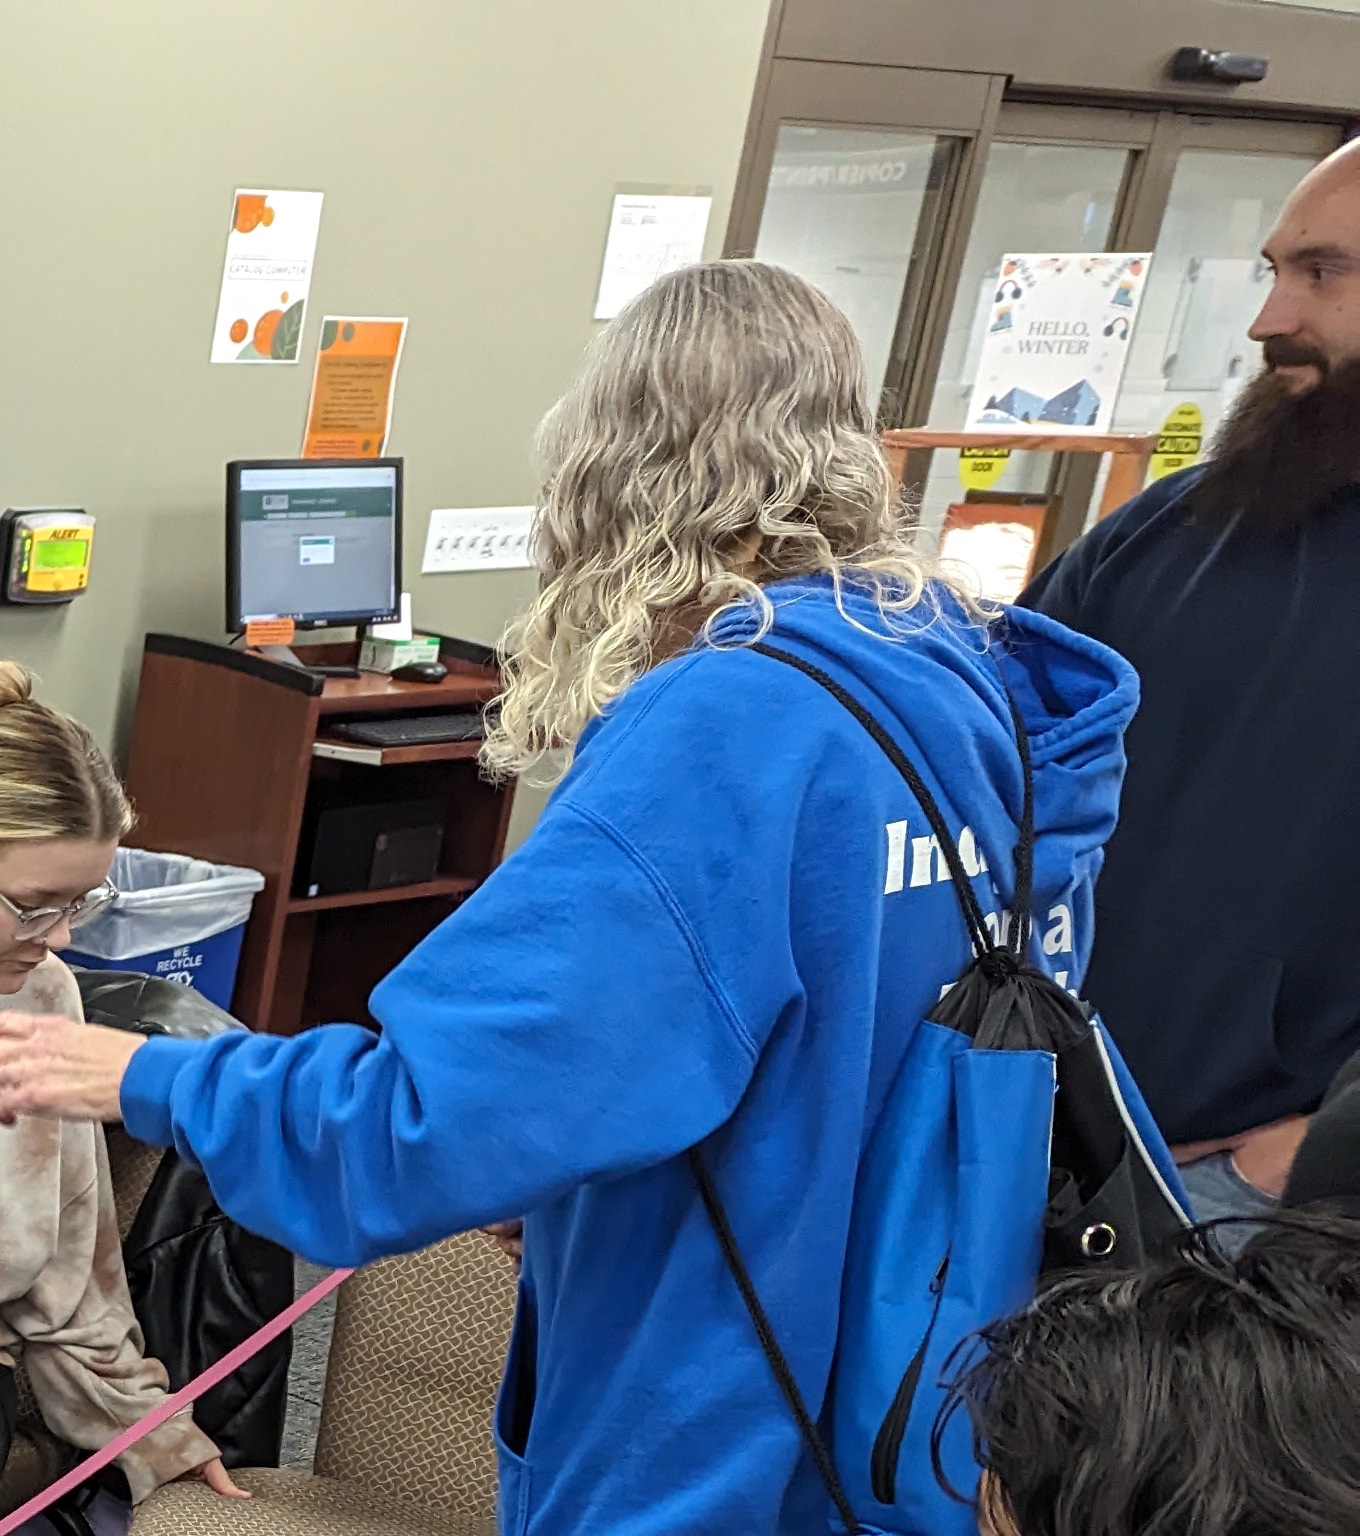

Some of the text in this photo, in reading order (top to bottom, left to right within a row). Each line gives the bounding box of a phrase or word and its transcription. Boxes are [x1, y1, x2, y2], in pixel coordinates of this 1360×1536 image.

[230, 263, 306, 276] CATALOG COMPUTER
[1027, 321, 1090, 338] HELLO,
[1018, 339, 1090, 355] WINTER
[1158, 438, 1199, 452] CAUTION
[49, 529, 80, 539] ALERT
[173, 946, 189, 958] WE
[156, 955, 202, 972] RECYCLE
